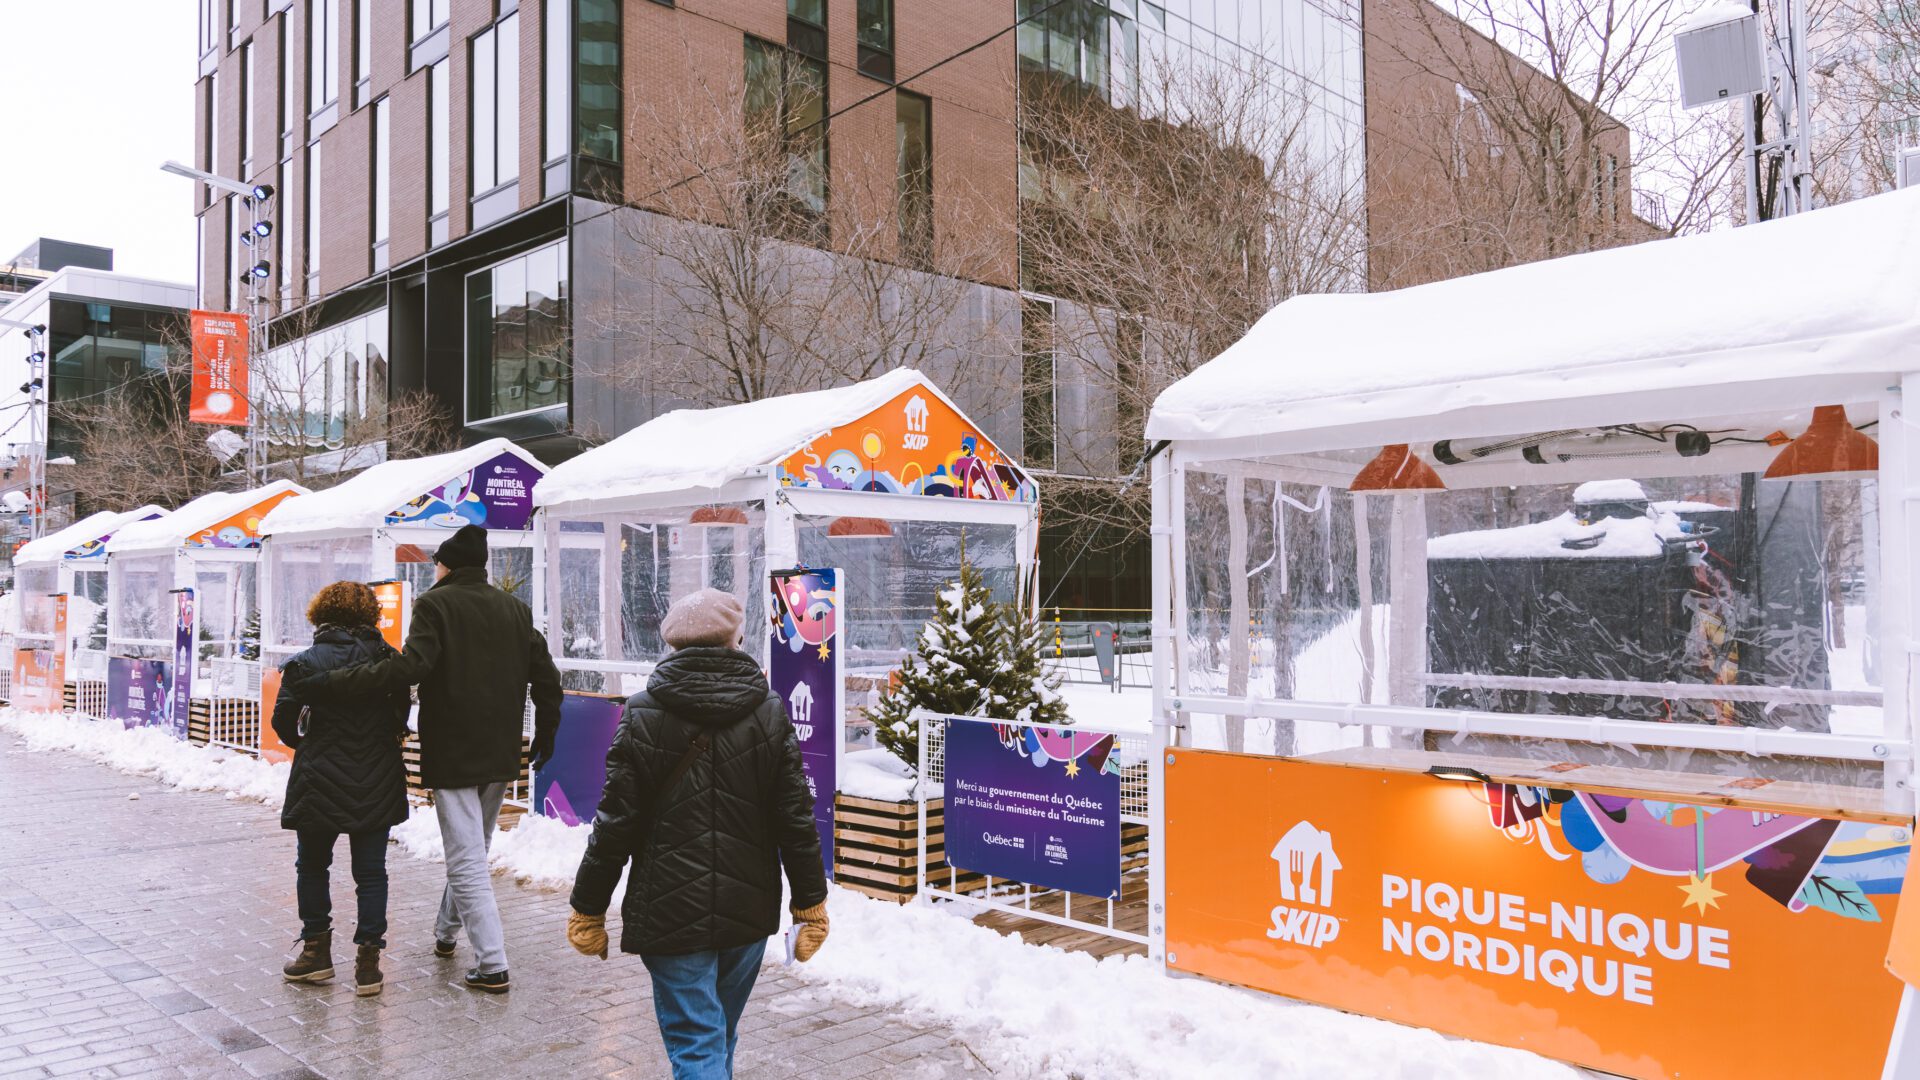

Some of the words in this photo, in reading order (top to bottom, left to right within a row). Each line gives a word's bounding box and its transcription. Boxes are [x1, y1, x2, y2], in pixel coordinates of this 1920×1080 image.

[902, 433, 928, 450] SKIP
[486, 488, 495, 496] EN
[496, 488, 527, 498] LUMIÈRE
[487, 478, 525, 489] MONTRÉAL
[956, 779, 977, 792] Merci
[978, 784, 988, 794] au
[989, 787, 1049, 803] gouvernement
[1051, 793, 1063, 805] du
[1065, 794, 1103, 810] Québec
[954, 796, 966, 807] par
[967, 795, 975, 806] le
[975, 798, 993, 809] biais
[994, 800, 1005, 811] du
[1006, 804, 1046, 818] ministère
[1047, 807, 1060, 820] du
[1061, 810, 1105, 827] Tourisme
[983, 832, 1012, 847] Québec
[1266, 905, 1340, 948] SKIP
[1382, 874, 1730, 969] PIQUE-NIQUE
[1382, 918, 1653, 1005] NORDIQUE
